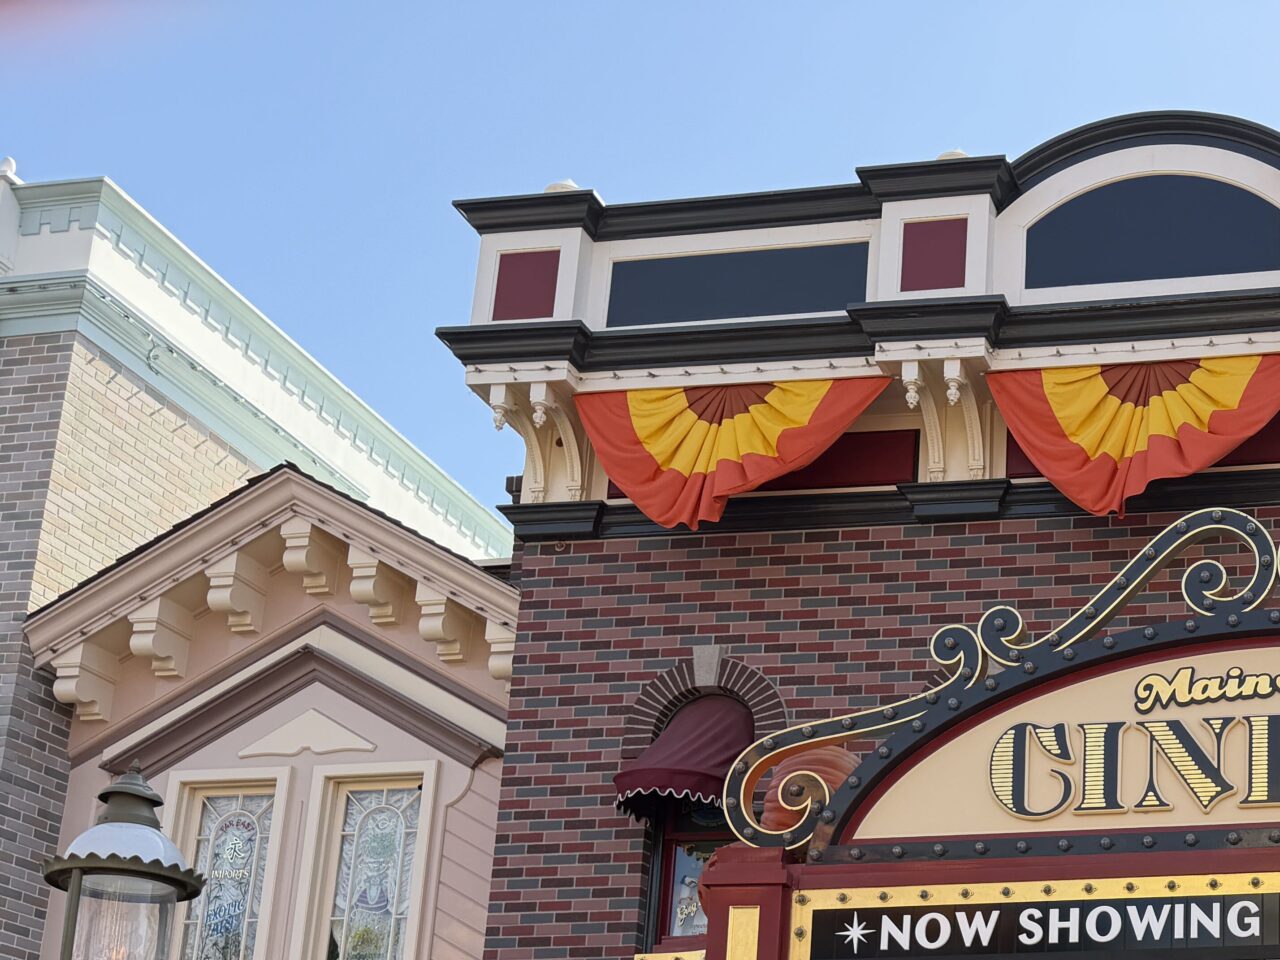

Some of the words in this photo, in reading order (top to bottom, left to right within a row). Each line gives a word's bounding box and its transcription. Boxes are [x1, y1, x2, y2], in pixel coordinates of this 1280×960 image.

[1134, 664, 1274, 715] Main
[879, 910, 1000, 951] NOW
[1017, 900, 1261, 946] SHOWING
